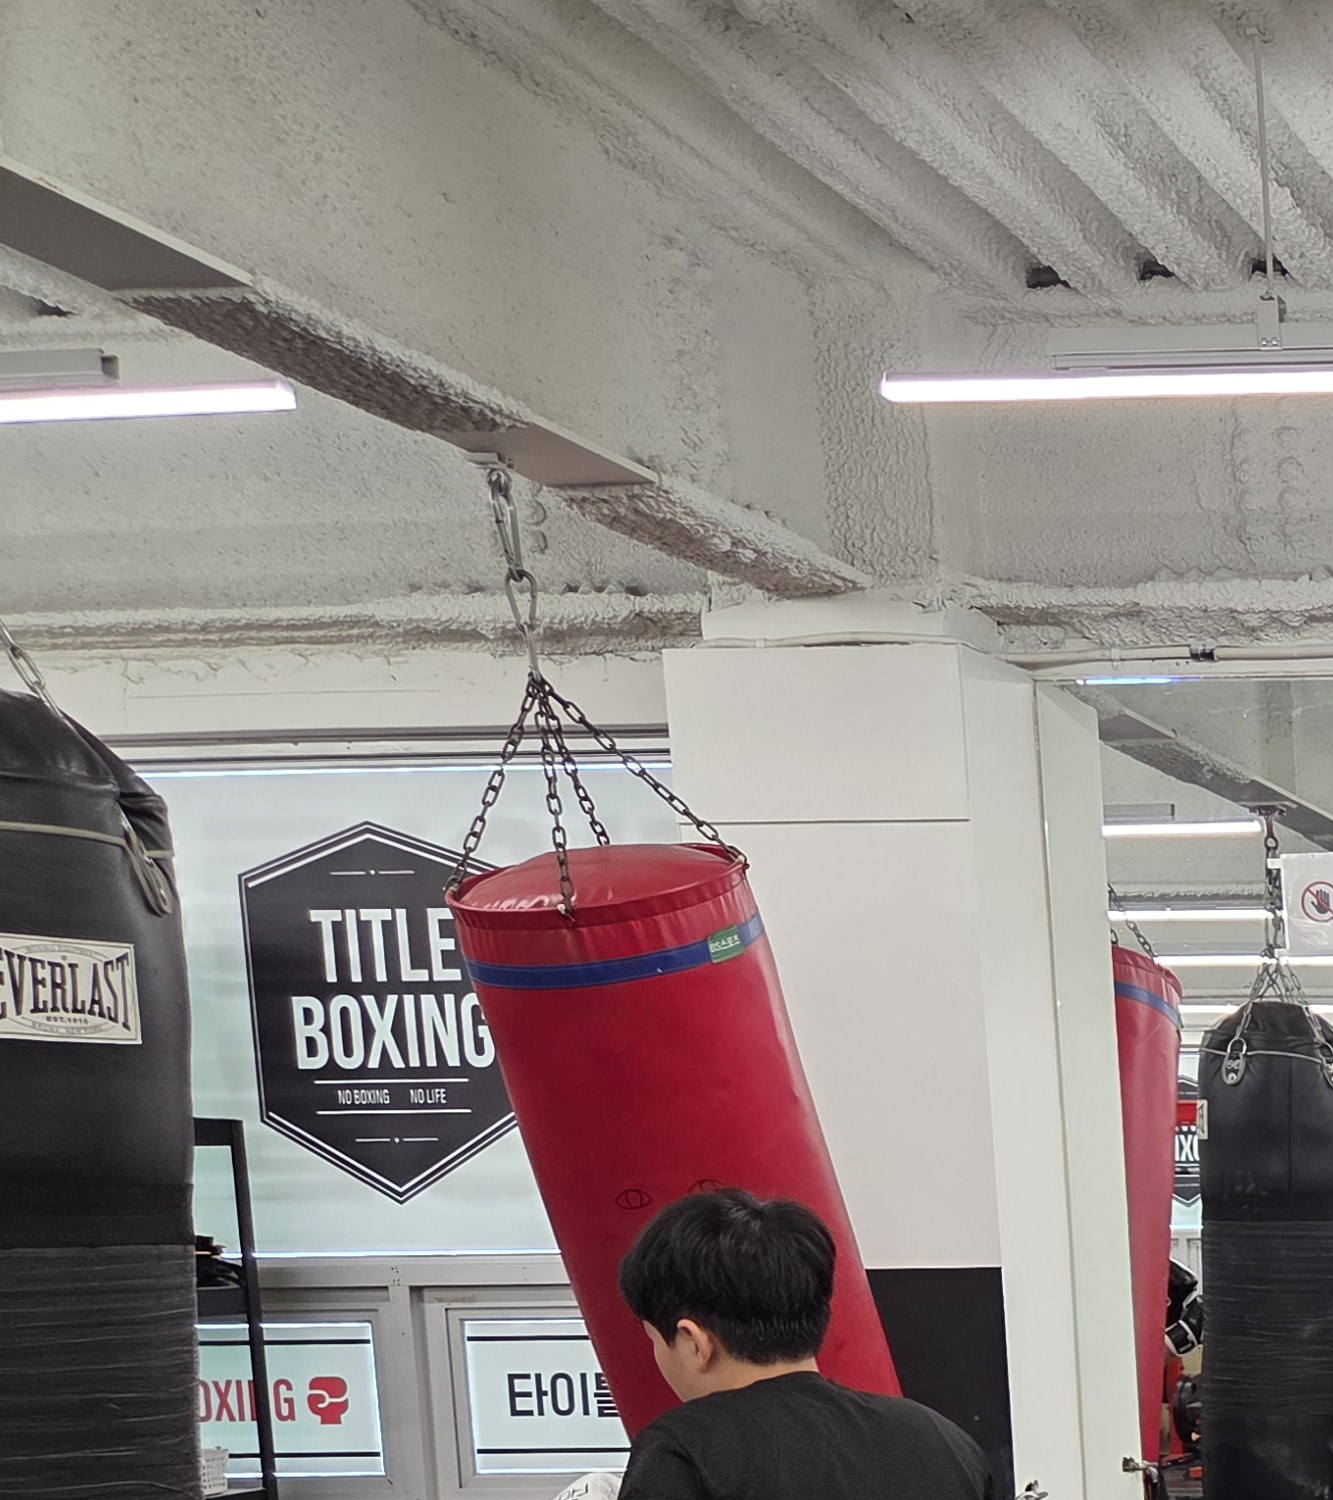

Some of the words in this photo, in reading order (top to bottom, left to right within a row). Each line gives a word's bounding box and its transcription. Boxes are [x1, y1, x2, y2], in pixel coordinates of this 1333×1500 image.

[309, 908, 462, 982] TITLE
[291, 992, 496, 1069] BOXING
[337, 1090, 352, 1104] NO
[353, 1089, 390, 1104] BOXING
[410, 1089, 425, 1103] NO
[425, 1089, 447, 1103] LIFE
